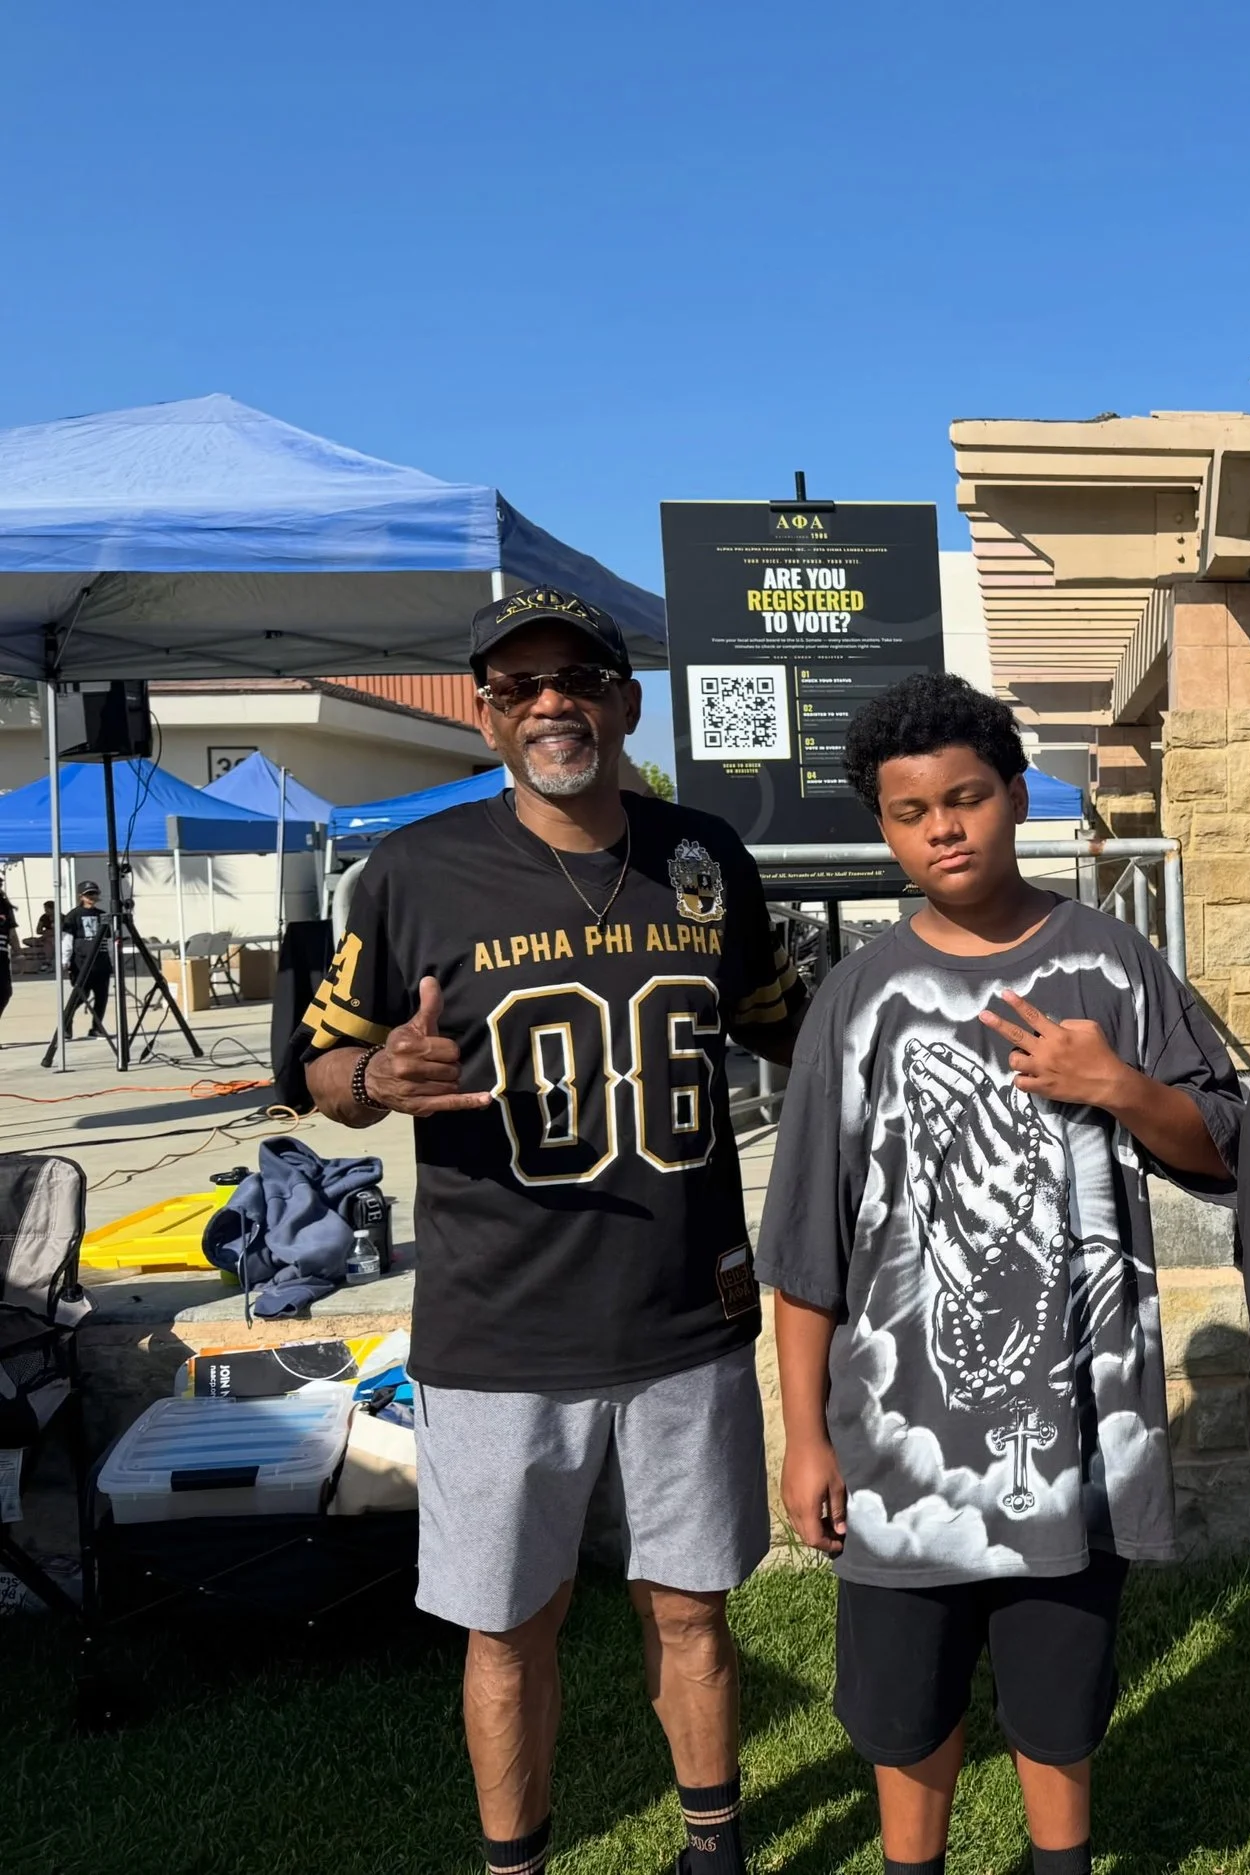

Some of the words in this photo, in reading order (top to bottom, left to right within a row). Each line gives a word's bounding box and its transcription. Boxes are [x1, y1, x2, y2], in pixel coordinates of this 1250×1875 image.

[763, 567, 802, 589] ARE
[806, 567, 846, 590] YOU
[747, 590, 864, 611] REGISTERED
[761, 611, 788, 633] TO
[792, 611, 851, 633] VOTE?
[801, 670, 810, 678] 01
[803, 704, 813, 712] 02
[805, 737, 815, 745] 03
[807, 771, 816, 779] 04
[474, 929, 573, 972] ALPHA
[584, 924, 633, 956] PHI
[646, 923, 722, 956] ALPHA
[486, 975, 721, 1187] 06
[220, 1365, 230, 1388] JOIN
